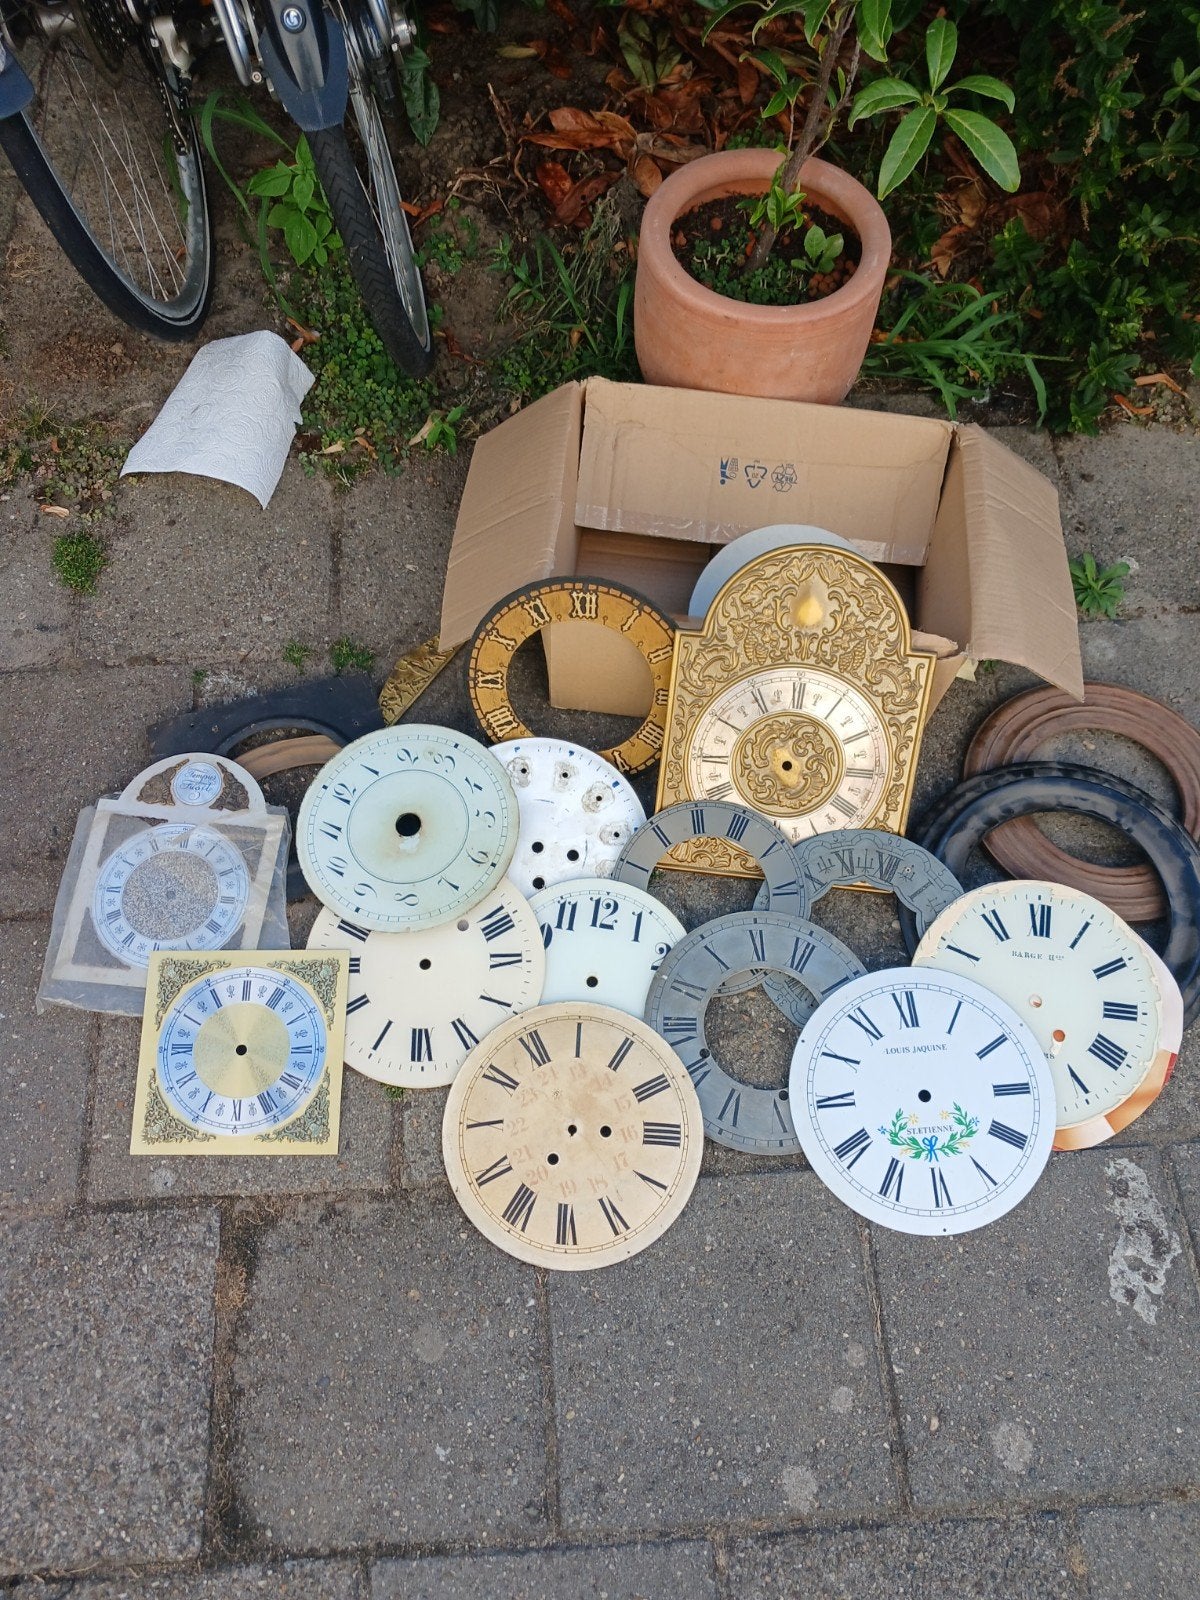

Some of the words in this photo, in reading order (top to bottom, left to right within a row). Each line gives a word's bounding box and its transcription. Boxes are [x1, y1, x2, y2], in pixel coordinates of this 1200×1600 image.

[569, 589, 599, 619] XII
[554, 899, 578, 932] 11
[589, 896, 619, 931] 12
[631, 910, 643, 943] 1
[1027, 903, 1052, 939] XII
[650, 942, 671, 971] 2
[891, 990, 920, 1030] XII
[885, 1046, 911, 1055] LOUIS
